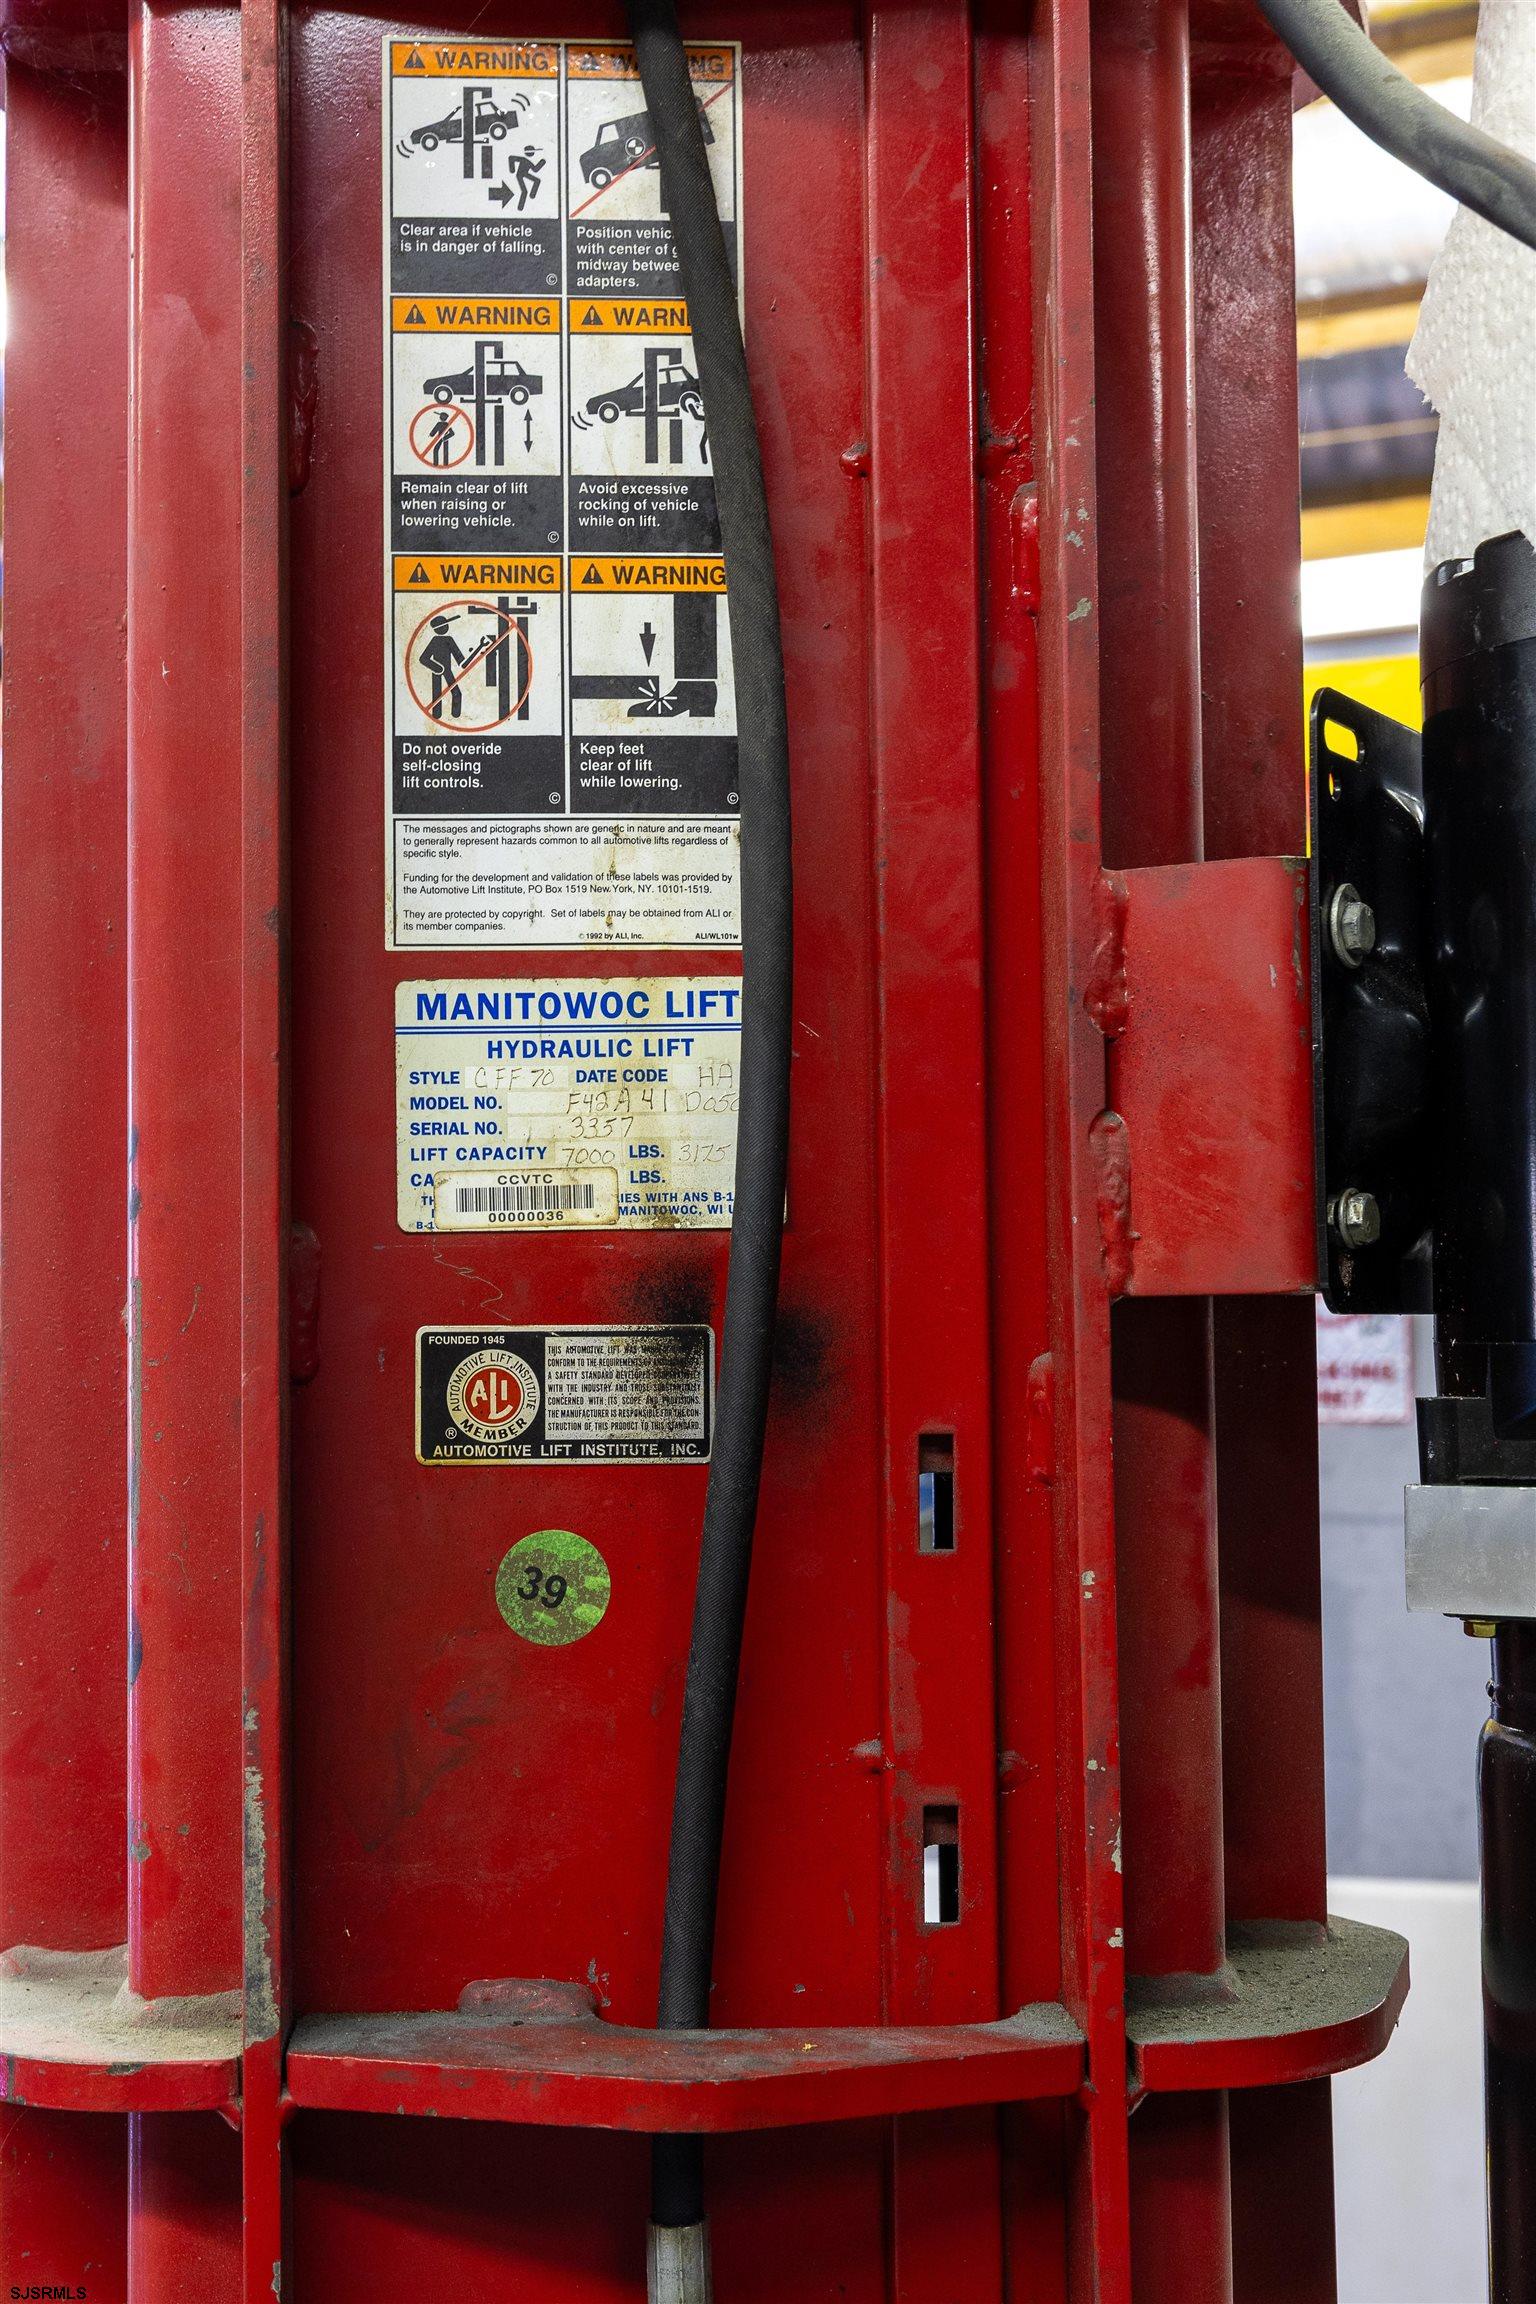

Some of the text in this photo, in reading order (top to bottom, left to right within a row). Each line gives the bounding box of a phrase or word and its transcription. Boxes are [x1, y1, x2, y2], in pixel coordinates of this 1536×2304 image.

[436, 52, 549, 71] WARNING
[400, 223, 533, 236] Clear area if vehicle
[576, 225, 675, 239] Position vehic
[400, 239, 546, 255] is in danger of falling.
[576, 242, 605, 254] with
[608, 243, 651, 255] center
[654, 243, 668, 255] of
[576, 258, 629, 274] midway
[576, 275, 640, 290] adapters.
[435, 305, 551, 324] WARNING
[401, 481, 528, 493] Remain clear of lift
[578, 481, 689, 494] Avoid excessive
[400, 497, 506, 513] when raising or
[578, 498, 699, 513] rocking of vehicle
[401, 514, 515, 530] lowering vehicle.
[578, 514, 660, 527] while on lift.
[439, 564, 555, 584] WARNING
[611, 565, 727, 586] WARNING
[402, 742, 502, 754] Do not overide
[580, 742, 645, 757] Keep feet
[402, 758, 481, 774] self-closing
[580, 758, 653, 771] clear of lift
[402, 775, 484, 788] lift controls.
[580, 775, 682, 790] while lowering.
[402, 824, 732, 836] The messages and pictographs shown are generic in nature and are meant
[402, 836, 729, 848] to generally represent hazards common to all automotive lifts regardless of
[402, 873, 733, 884] Funding for the development and validation of these labels was provided by
[402, 885, 418, 894] the
[419, 885, 470, 894] Automotive
[471, 885, 486, 894] Lift
[487, 885, 526, 896] Institute,
[527, 885, 543, 894] PO
[545, 885, 563, 894] Box
[565, 885, 588, 894] 1519
[611, 885, 636, 896] York,
[637, 885, 654, 894] NY.
[657, 885, 712, 894] 10101-1519.
[416, 989, 740, 1021] MANITOWOC LIFT
[487, 1037, 695, 1059] HYDRAULIC LIFT
[409, 1071, 460, 1085] STYLE
[576, 1069, 618, 1083] DATE
[622, 1068, 668, 1082] CODE
[409, 1096, 469, 1110] MODEL
[474, 1096, 503, 1109] NO.
[409, 1121, 470, 1136] SERIAL
[474, 1121, 503, 1135] NO.
[410, 1147, 448, 1161] LIFT
[455, 1145, 547, 1162] CAPACITY
[561, 1147, 617, 1167] 7000
[629, 1144, 665, 1158] LBS.
[497, 1174, 553, 1187] CCVTC
[630, 1169, 666, 1183] LBS.
[618, 1192, 641, 1203] IES
[645, 1192, 678, 1203] WITH
[682, 1191, 709, 1202] ANS
[487, 1210, 564, 1223] 00000036
[618, 1204, 724, 1216] MANITOWOC, WI
[428, 1335, 505, 1344] FOUNDED 1945
[449, 1352, 537, 1412] AUTOMOTIVE LIFT INSTITUTE
[459, 1417, 528, 1440] MEMBER
[547, 1421, 582, 1431] STRUCTION
[594, 1421, 609, 1431] THIS
[610, 1421, 638, 1431] PRODUCT
[433, 1442, 701, 1458] AUTOMOTIVE LIFT INSTITUTE, INC.
[517, 1566, 568, 1609] 39
